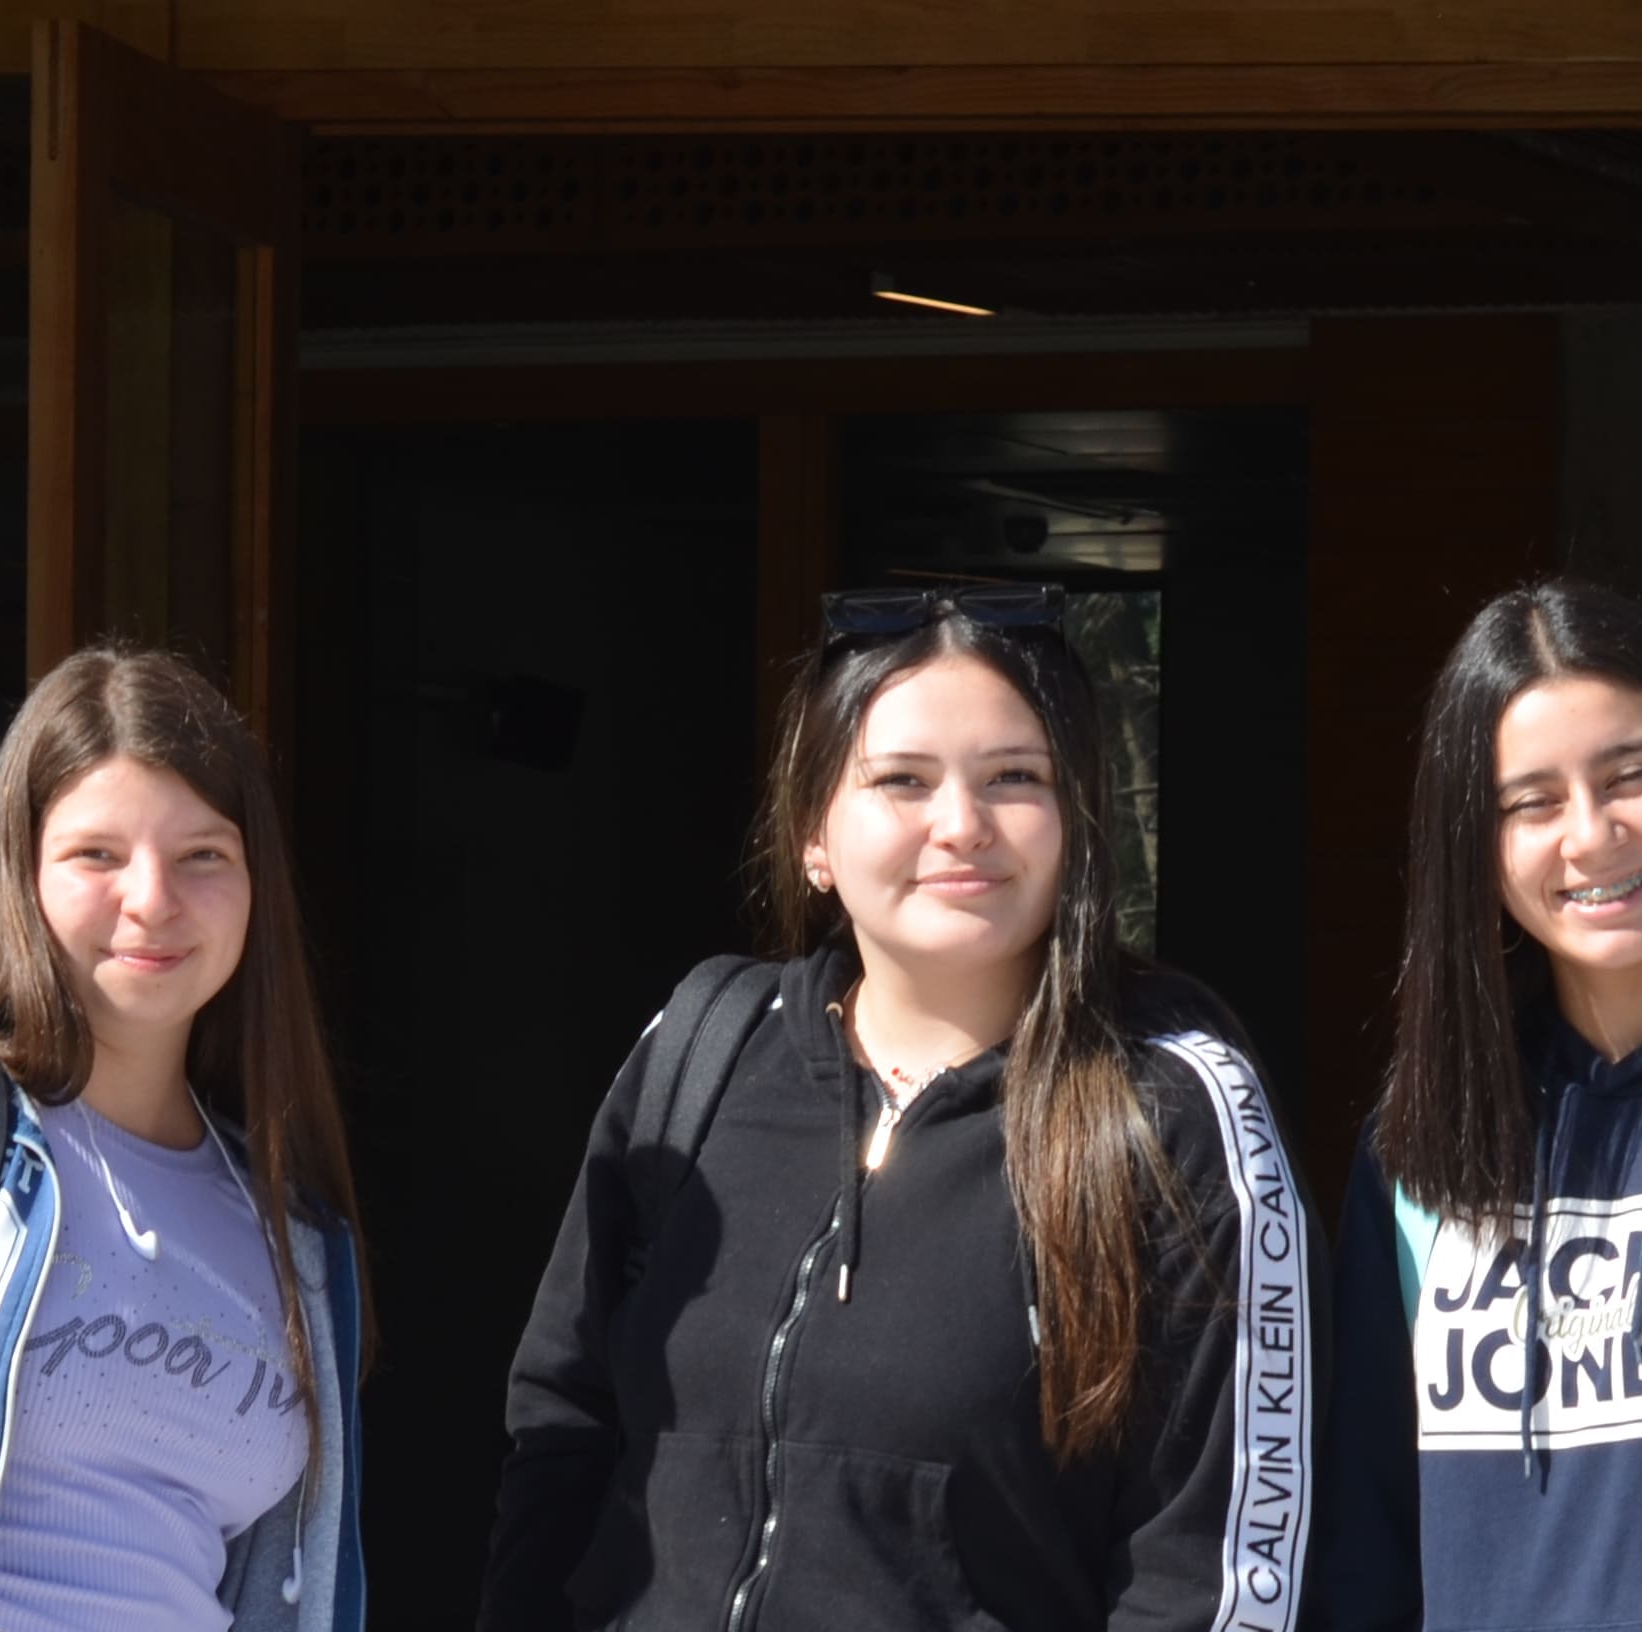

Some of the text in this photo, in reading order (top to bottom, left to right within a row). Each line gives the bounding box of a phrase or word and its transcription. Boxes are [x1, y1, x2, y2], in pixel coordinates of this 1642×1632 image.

[1232, 1083, 1290, 1262] CALVIN
[1257, 1283, 1294, 1415] KLEIN
[1246, 1436, 1294, 1604] CALVIN
